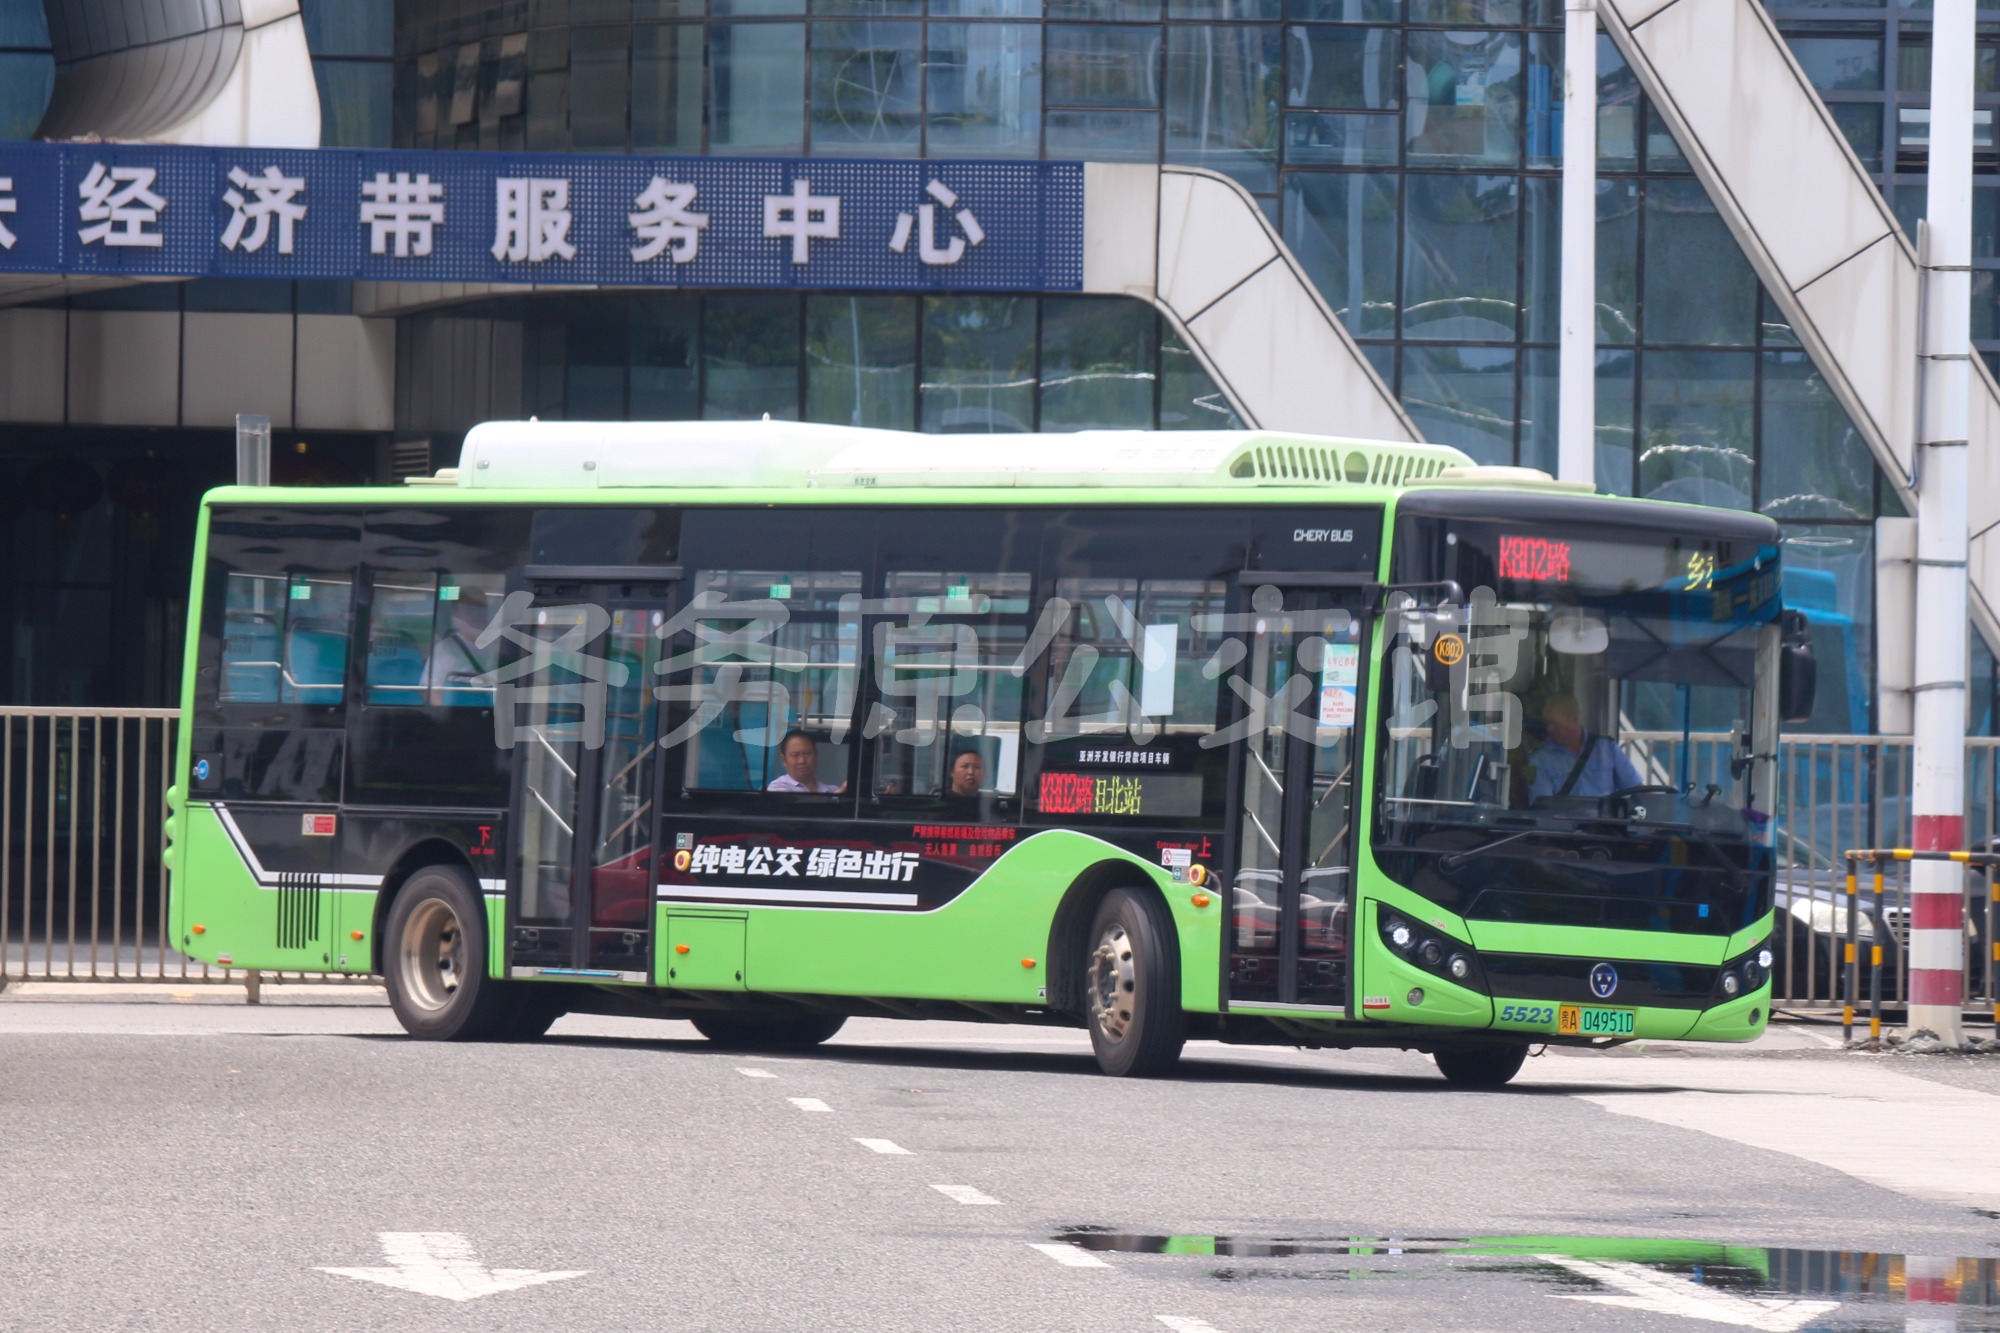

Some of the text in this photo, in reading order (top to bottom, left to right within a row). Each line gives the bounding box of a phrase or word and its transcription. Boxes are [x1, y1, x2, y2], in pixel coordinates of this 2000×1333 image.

[1293, 529, 1353, 542] CHERY BUS
[1499, 536, 1570, 581] K802路
[1439, 641, 1460, 658] K802
[1078, 750, 1170, 765] 亚洲开发银行贷款项目车辆
[1039, 772, 1095, 814] K802路
[478, 825, 492, 847] 下
[1197, 836, 1211, 858] 上
[690, 844, 920, 882] 纯电公交 绿色出行
[1500, 1006, 1554, 1024] 5523
[1584, 1011, 1634, 1033] 04951D
